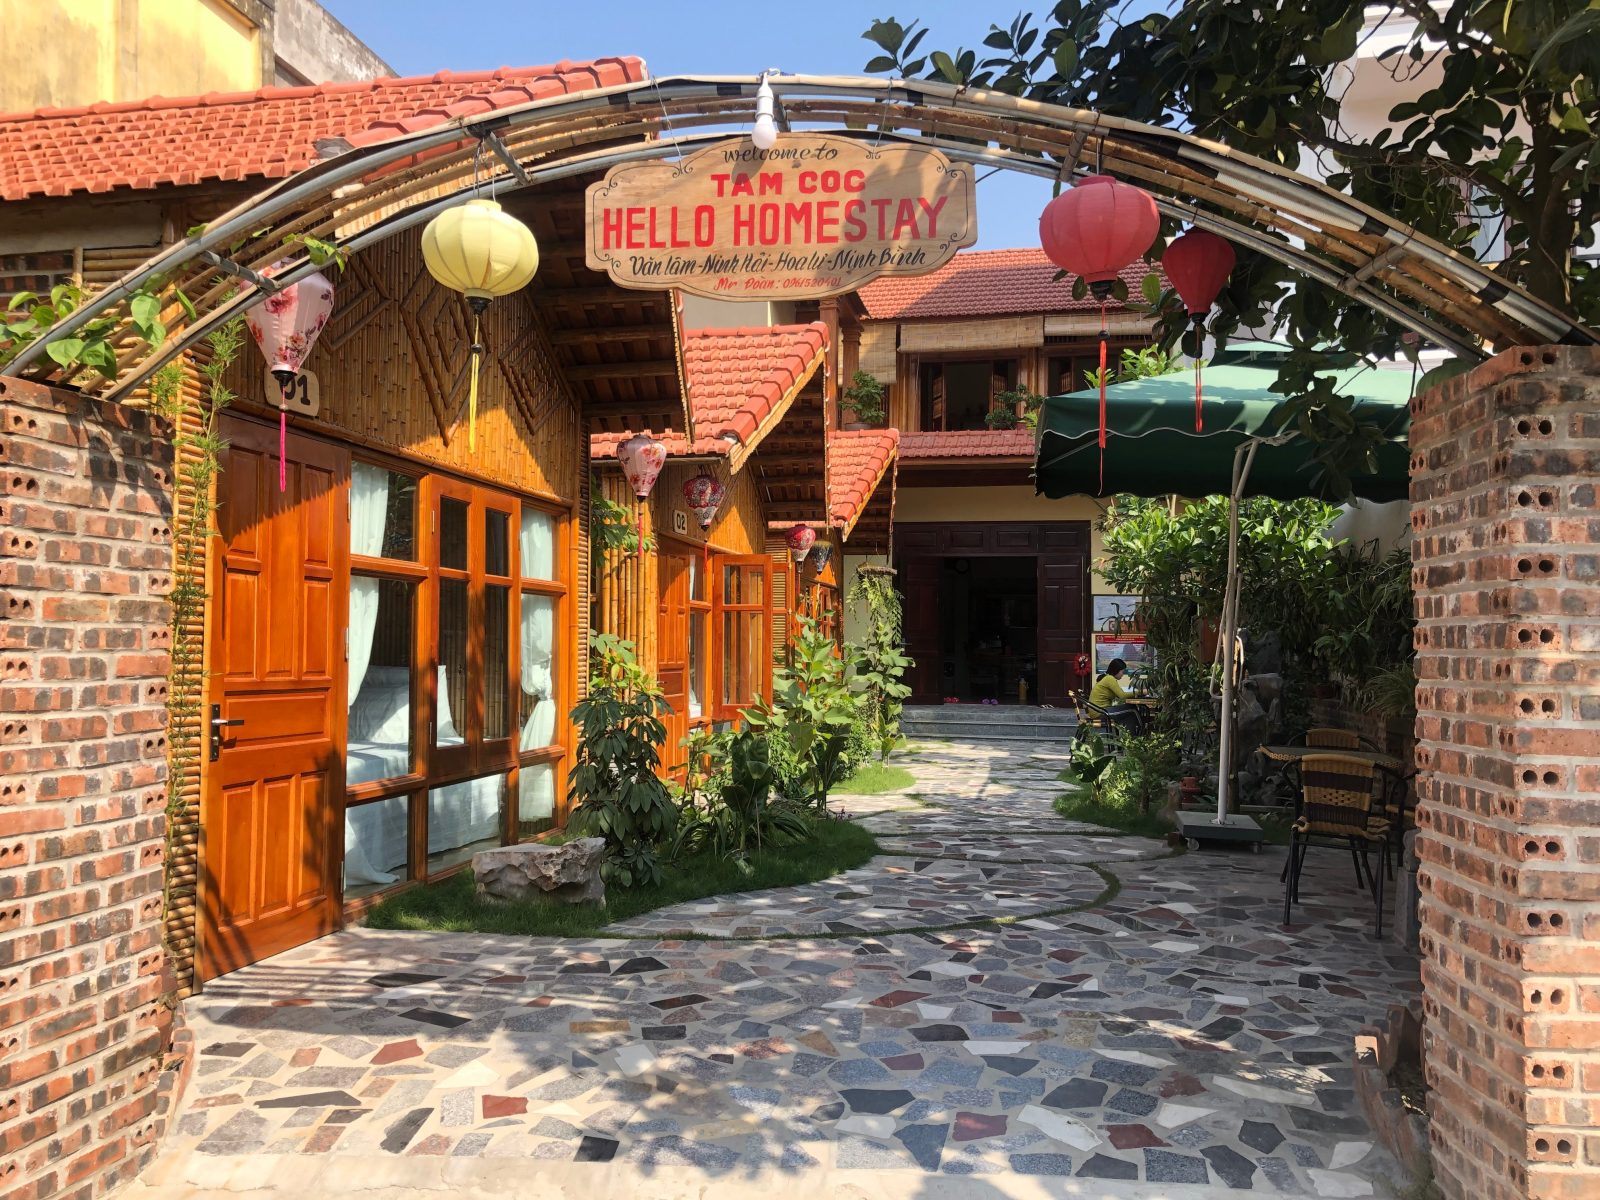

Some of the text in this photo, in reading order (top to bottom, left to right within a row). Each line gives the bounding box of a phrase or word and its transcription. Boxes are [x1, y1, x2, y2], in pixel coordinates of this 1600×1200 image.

[722, 142, 838, 163] welcome to
[710, 169, 866, 198] TAM COC
[602, 196, 948, 250] HELLO HOMESTAY
[714, 275, 738, 291] Mr
[676, 513, 686, 531] 02
